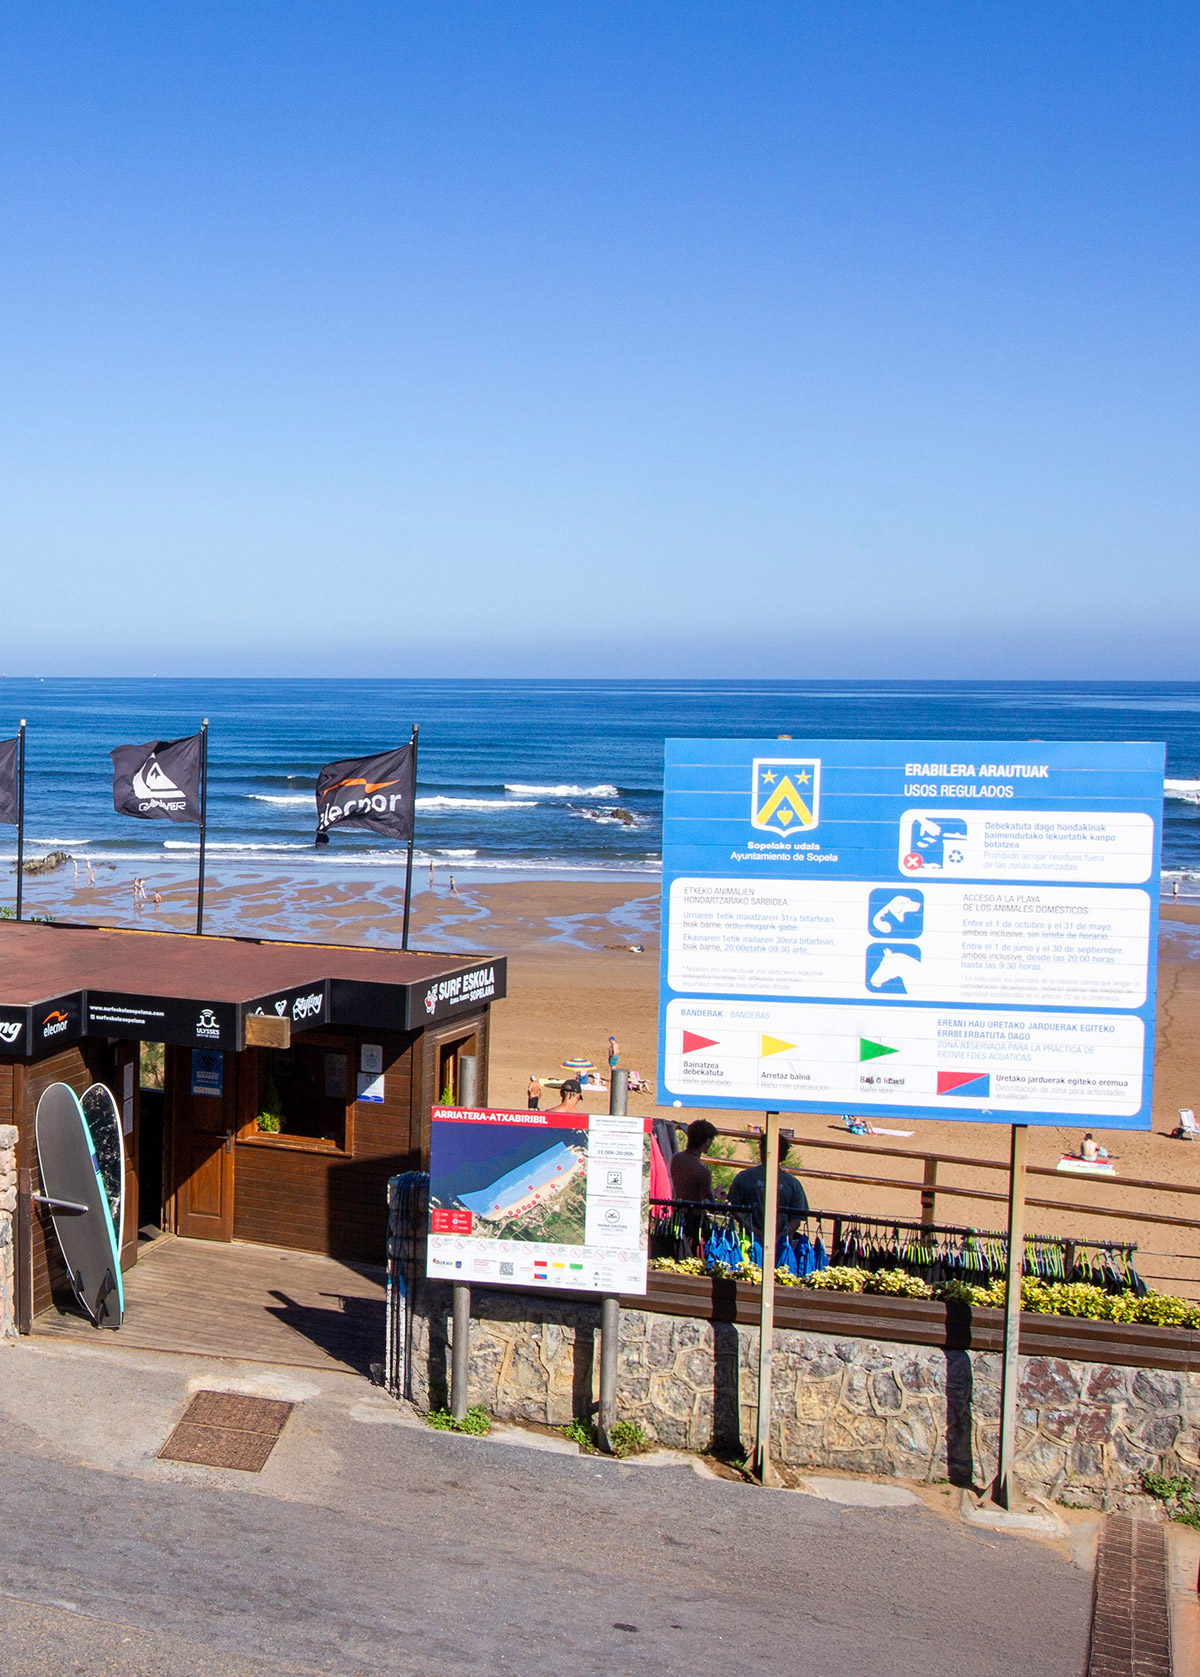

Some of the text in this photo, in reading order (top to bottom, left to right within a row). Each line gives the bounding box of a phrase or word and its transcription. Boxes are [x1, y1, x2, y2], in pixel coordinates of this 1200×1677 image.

[905, 764, 1048, 777] ERABILERA ARAUTUAK
[905, 785, 1014, 798] USOS REGULADOS
[985, 822, 1106, 832] Debekatuta dago hondakinak
[985, 832, 1116, 842] baimendutako lekuetatik kanpo
[748, 841, 791, 850] Sopelako
[731, 852, 791, 861] Ayuntamiento
[807, 853, 838, 862] Sopela
[983, 852, 1020, 860] Prohibido
[1022, 853, 1047, 862] arrojar
[1085, 854, 1105, 862] fuera
[995, 861, 1006, 869] las
[1033, 863, 1077, 871] autorizadas
[684, 887, 713, 895] ETXEKO
[684, 897, 748, 905] HONDARTZARAKO
[963, 894, 995, 902] ACCESO
[1005, 895, 1014, 903] LA
[1017, 895, 1040, 903] PLAYA
[976, 904, 991, 912] LOS
[963, 919, 983, 928] Entre
[986, 920, 993, 928] el
[996, 920, 999, 928] 1
[1002, 920, 1012, 928] de
[1015, 921, 1045, 929] octubre
[1047, 923, 1051, 931] y
[1064, 922, 1073, 930] 31
[1077, 922, 1086, 930] de
[962, 942, 982, 951] Entre
[985, 943, 992, 951] el
[995, 943, 998, 951] 1
[1014, 944, 1033, 953] junio
[1052, 945, 1062, 953] 30
[961, 952, 987, 960] ambos
[1053, 954, 1064, 962] las
[1092, 955, 1114, 963] horas
[961, 961, 983, 969] hasta
[985, 962, 997, 970] las
[999, 962, 1016, 970] 9:30
[439, 977, 462, 1000] SURF
[463, 967, 494, 992] ESKOLA
[470, 985, 494, 1001] SOPELANA
[681, 1009, 770, 1019] BANDERAK BANDERAS
[43, 1020, 68, 1037] elecnor
[968, 1020, 985, 1028] HAU
[987, 1021, 1025, 1029] URETAKO
[1027, 1023, 1077, 1031] JARDUERAK
[1080, 1024, 1115, 1033] EGITEKO
[1008, 1032, 1030, 1040] DAGO
[1008, 1043, 1028, 1051] PARA
[1031, 1044, 1041, 1052] LA
[1085, 1046, 1094, 1054] DE
[683, 1061, 719, 1069] Bainatzea
[683, 1068, 724, 1076] debekatuta
[1028, 1076, 1065, 1084] jarduerak
[1067, 1077, 1096, 1086] egiteko
[1069, 1088, 1085, 1096] para
[1086, 1088, 1125, 1096] actividades
[434, 1110, 548, 1124] ARRIATERA-ATXABIRIBIL
